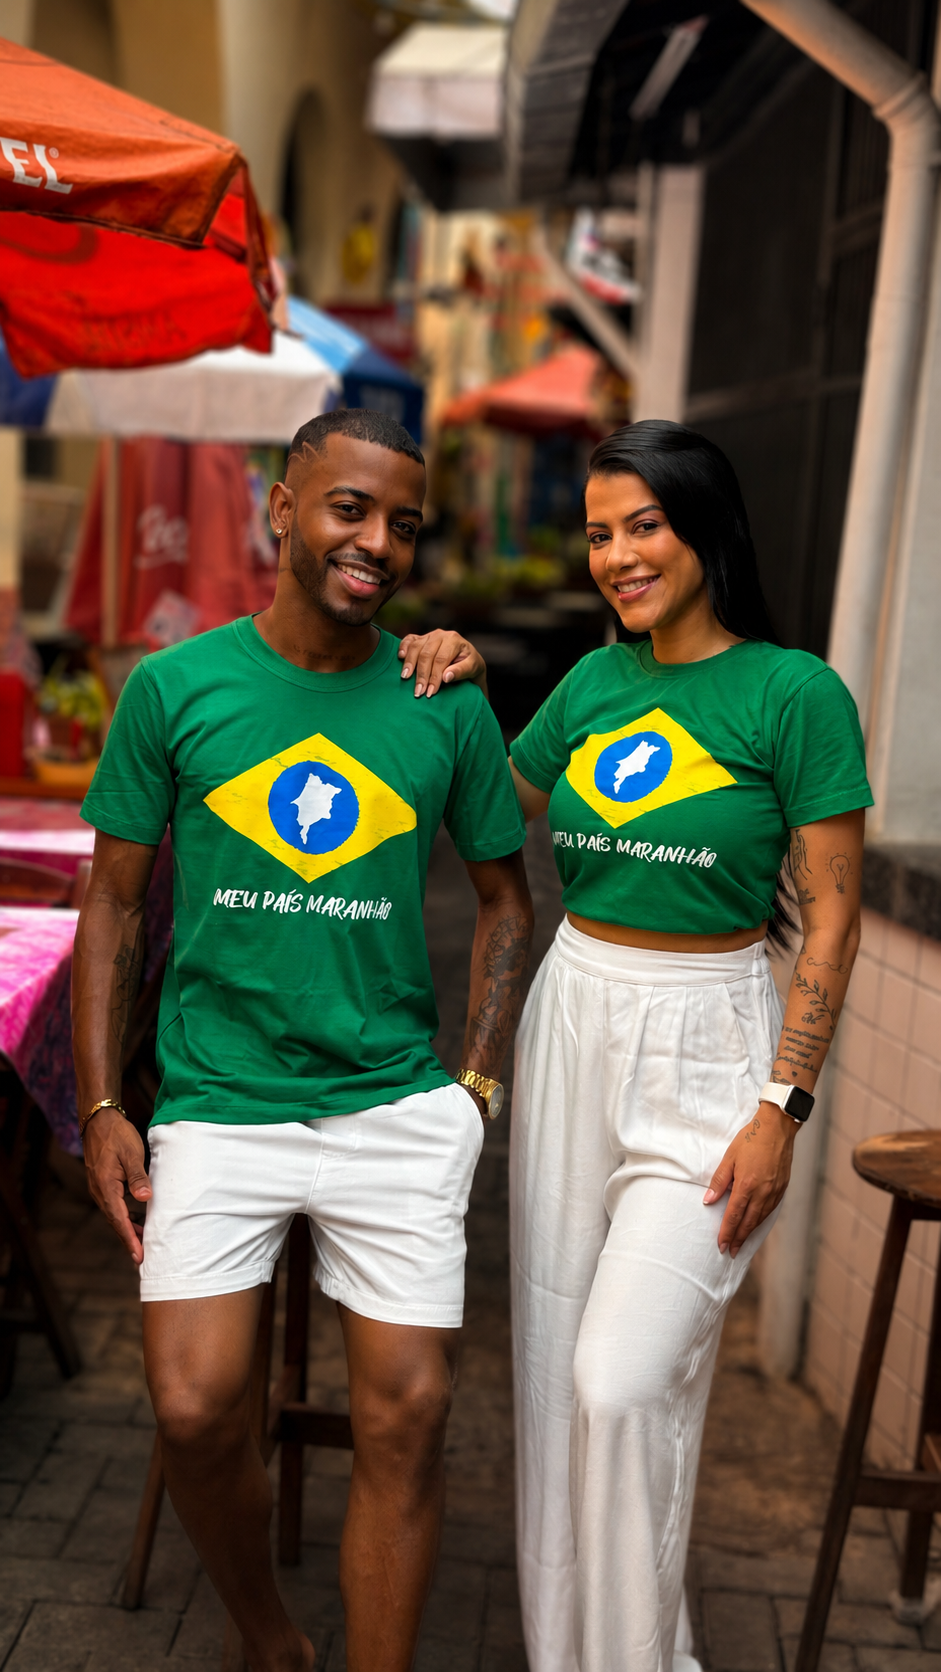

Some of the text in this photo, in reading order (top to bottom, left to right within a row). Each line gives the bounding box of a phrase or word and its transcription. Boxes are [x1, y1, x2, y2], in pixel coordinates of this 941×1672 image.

[576, 832, 611, 852] PAÍS
[616, 838, 717, 868] MARANHÃO
[213, 888, 392, 920] MEU PAÍS MARANHÃO
